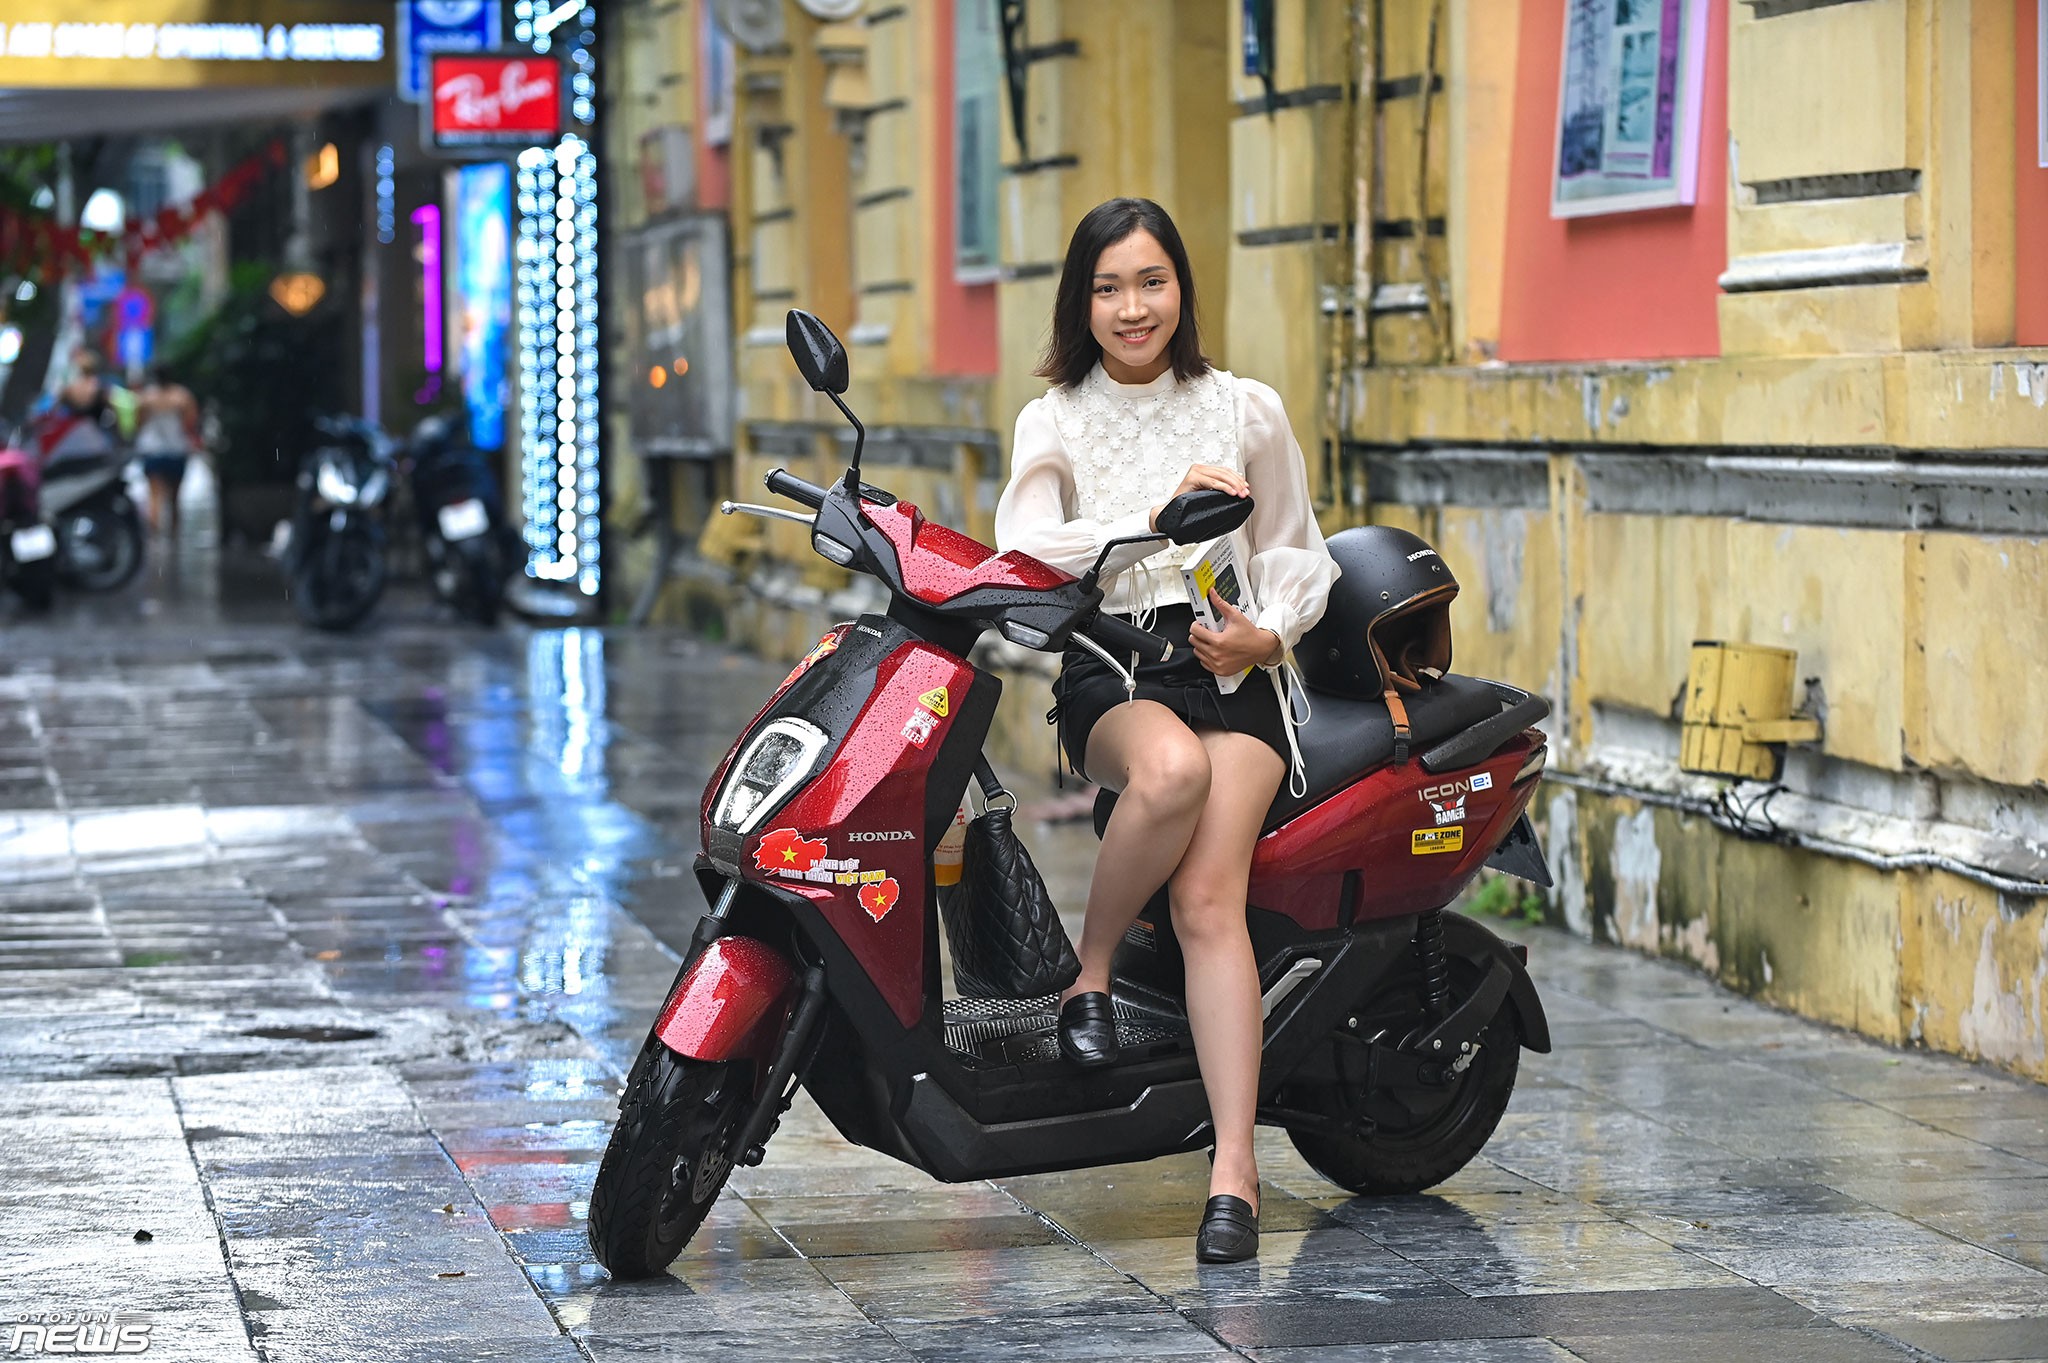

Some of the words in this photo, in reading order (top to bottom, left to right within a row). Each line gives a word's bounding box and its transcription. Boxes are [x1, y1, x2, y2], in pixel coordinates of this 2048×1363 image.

[1406, 549, 1437, 562] HONDA
[856, 624, 882, 639] HONDA
[900, 726, 925, 744] SLEEP
[1418, 779, 1470, 801] ICON
[1435, 807, 1466, 825] GAMER
[848, 830, 915, 842] HONDA
[1440, 830, 1461, 839] ZONE
[859, 870, 886, 884] NAM
